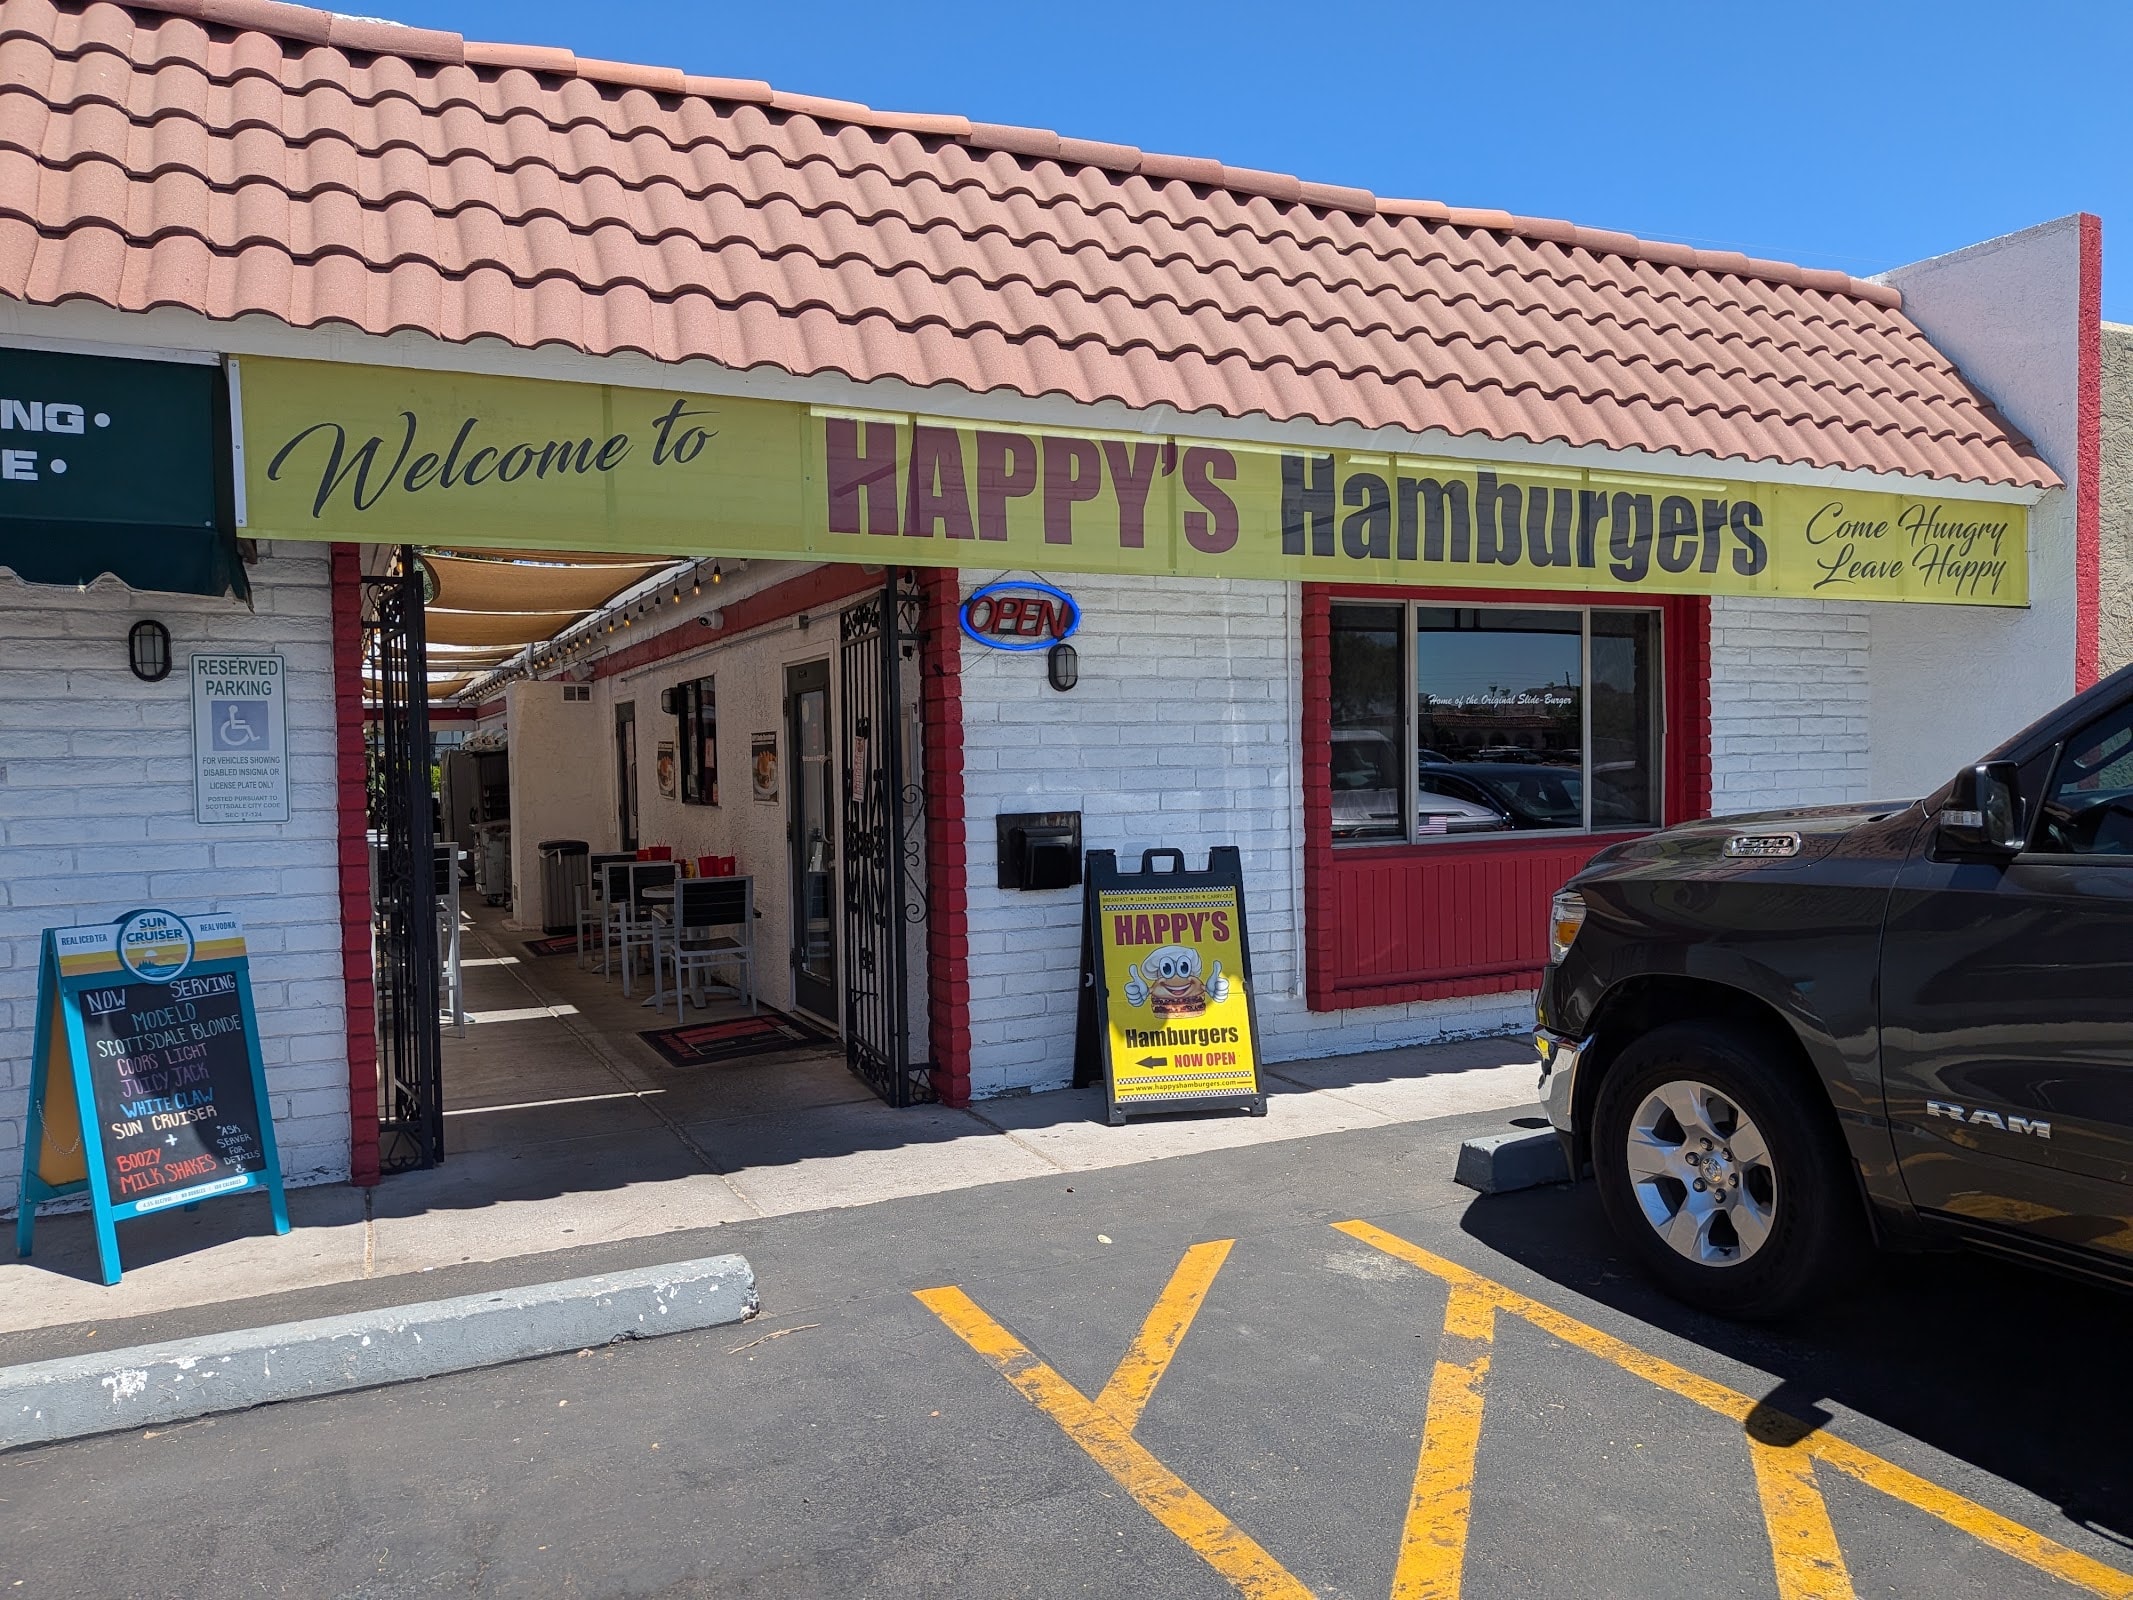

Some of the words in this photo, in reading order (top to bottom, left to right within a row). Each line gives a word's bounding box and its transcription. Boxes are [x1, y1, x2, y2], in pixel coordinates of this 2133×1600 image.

[267, 411, 634, 518] Welcome
[651, 398, 721, 466] to
[825, 416, 1240, 554] HAPPY'S
[1280, 449, 1767, 583] Hamburgers
[1806, 501, 1891, 545] Come
[1897, 503, 2009, 557] Hungry
[1813, 542, 1905, 591] Leave
[1912, 543, 2007, 597] Happy
[968, 595, 1070, 638] OPEN
[198, 659, 279, 676] RESERVED
[205, 680, 272, 696] PARKING
[1427, 693, 1452, 705] Home
[1454, 694, 1464, 709] of
[1466, 693, 1478, 705] the
[1481, 693, 1515, 709] Original
[1517, 692, 1572, 709] Slide-Burger
[202, 756, 216, 765] FOR
[217, 756, 249, 765] VEHICLES
[250, 756, 280, 765] SHOWING
[203, 768, 238, 777] DISABLED
[239, 768, 268, 776] INSIGNIA
[269, 768, 280, 776] OR
[209, 781, 236, 790] LICENSE
[237, 781, 257, 789] PLATE
[258, 781, 275, 789] ONLY
[138, 917, 167, 929] SUN
[200, 922, 215, 933] REAL
[215, 921, 237, 931] VODKA
[1114, 911, 1230, 946] HAPPY'S
[61, 935, 79, 946] REAL
[79, 934, 95, 945] ICED
[95, 933, 108, 944] TEA
[126, 929, 183, 945] CRUISER
[86, 988, 127, 1013] NOW
[169, 974, 236, 998] SERVING
[131, 1002, 197, 1032] MODELO
[96, 1027, 189, 1058] SCOTTSDALE
[190, 1014, 241, 1040] BLONDE
[1125, 1026, 1239, 1049] Hamburgers
[117, 1053, 159, 1077] COORS
[165, 1042, 209, 1066] LIGHT
[1174, 1053, 1203, 1068] NOW
[1206, 1051, 1236, 1067] OPEN
[120, 1073, 169, 1099] JUICY
[174, 1063, 210, 1087] JACK
[1135, 1079, 1237, 1091] www.happyshamburgers.com
[120, 1097, 173, 1119] WHITE
[174, 1087, 214, 1110] CLAW
[111, 1119, 144, 1140] SUN
[151, 1105, 218, 1131] CRUISER
[1926, 1099, 2051, 1140] RAM
[216, 1133, 252, 1149] SERVER
[228, 1145, 246, 1155] FOR
[116, 1147, 162, 1173] BOOZY
[223, 1150, 261, 1165] DETAILS
[120, 1168, 165, 1195] MILK
[164, 1153, 218, 1183] SHAKES
